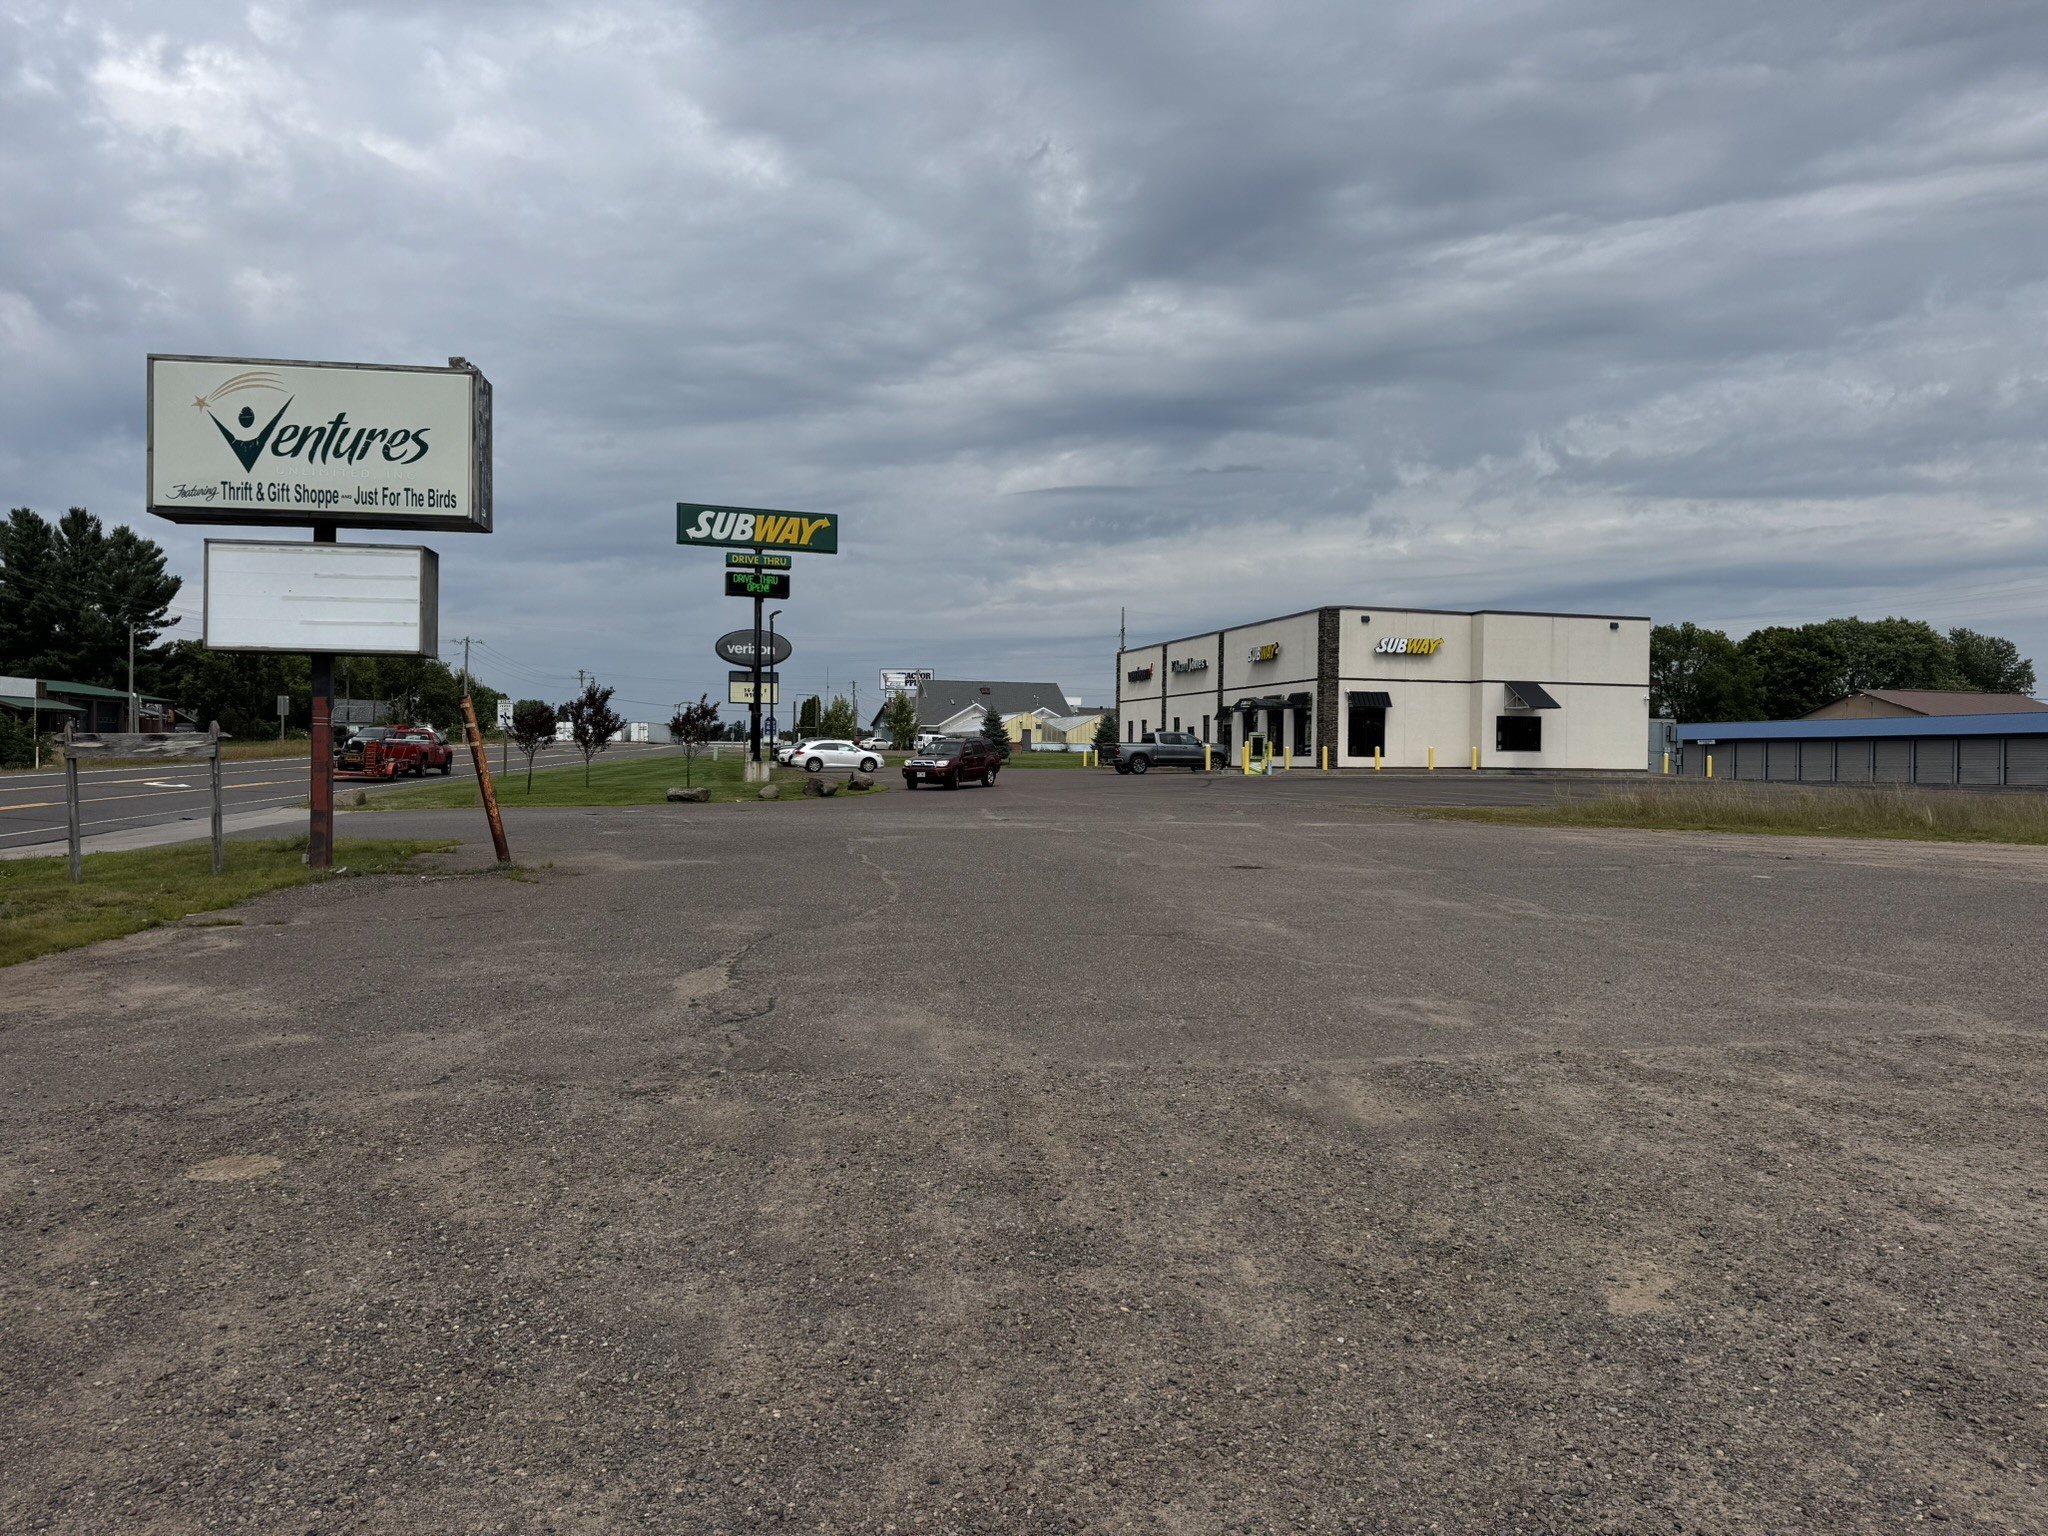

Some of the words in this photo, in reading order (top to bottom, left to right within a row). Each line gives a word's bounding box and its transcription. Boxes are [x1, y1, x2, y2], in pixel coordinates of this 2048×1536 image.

[207, 394, 431, 474] Ventures
[166, 484, 219, 501] Featuring
[221, 481, 253, 501] Thrift
[256, 482, 265, 502] &
[267, 482, 291, 502] Gift
[294, 483, 339, 508] Shoppe
[353, 486, 378, 506] Just
[382, 487, 401, 506] For
[403, 487, 425, 507] The
[428, 488, 457, 509] Birds
[686, 510, 831, 546] SUBWAY
[731, 554, 760, 565] DRIVE
[763, 556, 787, 566] THRU
[733, 573, 755, 584] DRIVE
[758, 574, 779, 585] THRU
[1247, 641, 1280, 664] SUBWAY
[1374, 637, 1445, 655] SUBWAY
